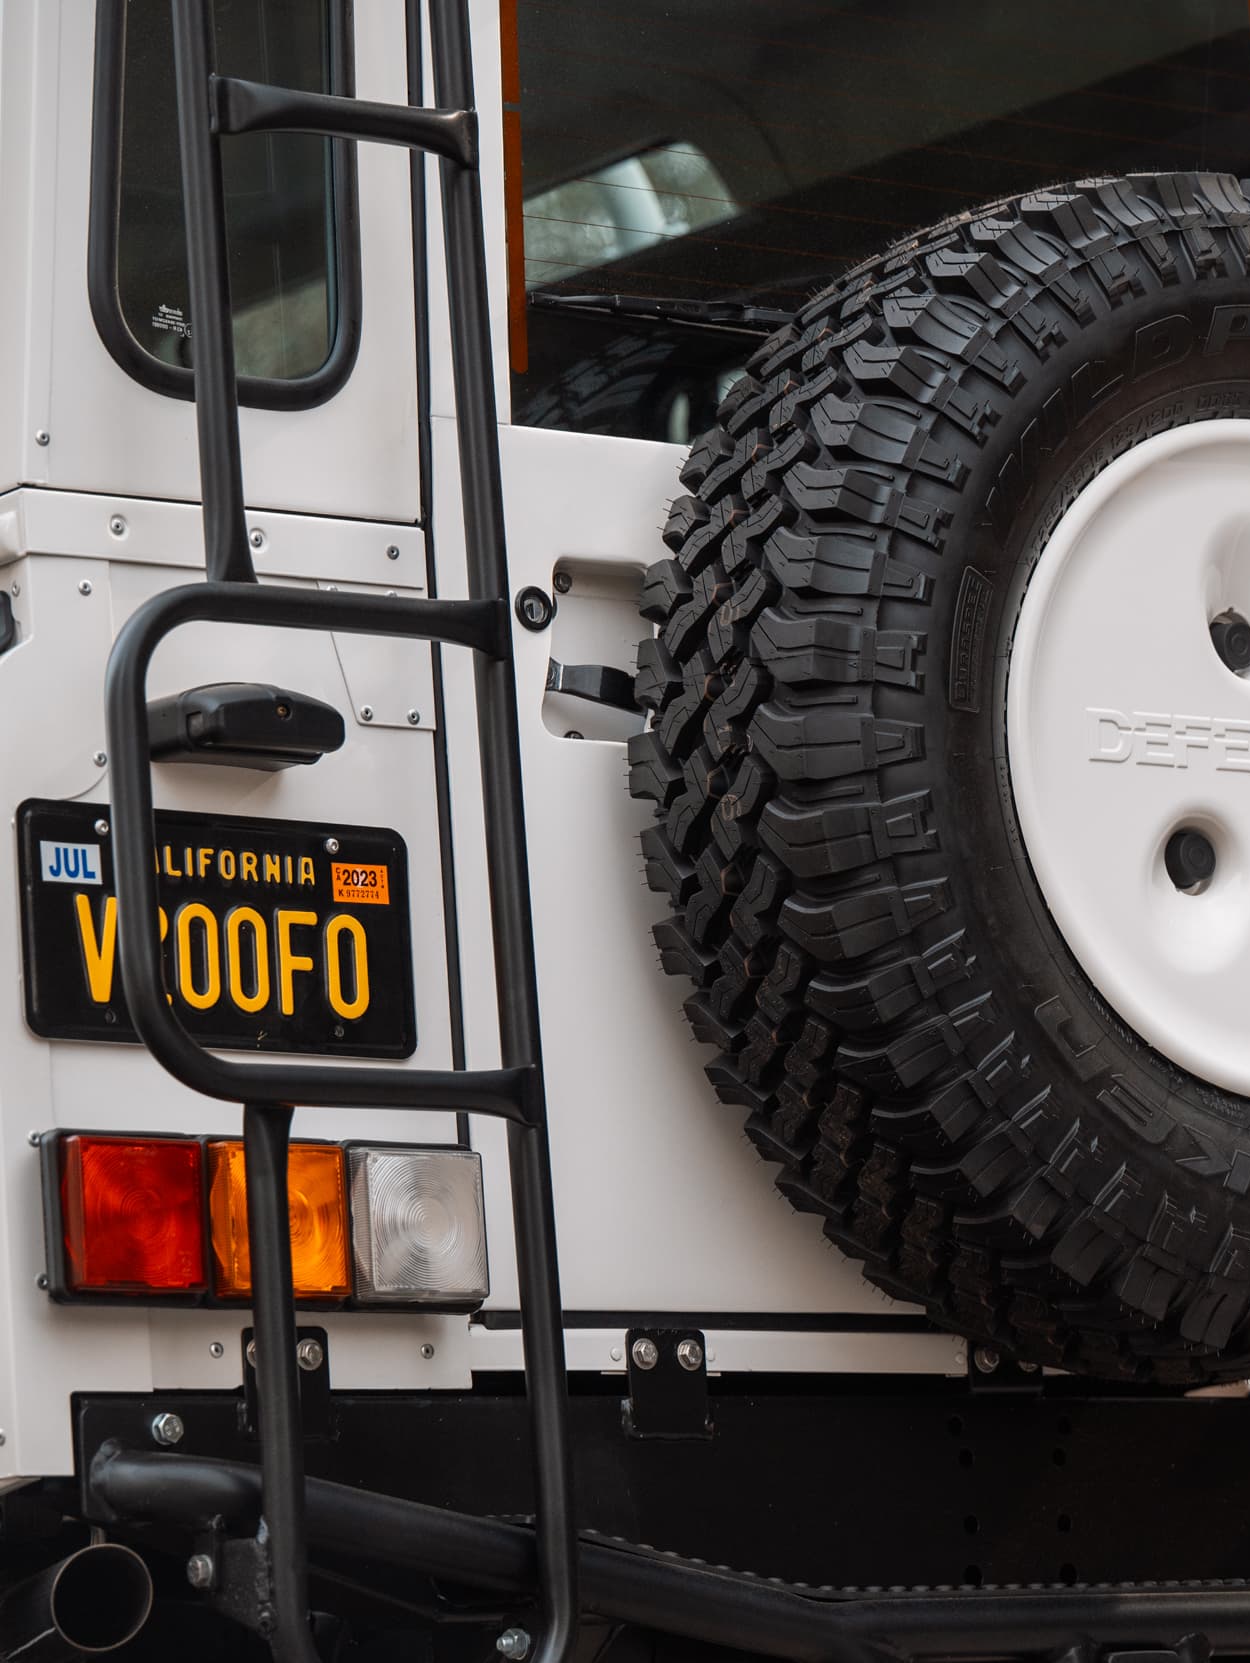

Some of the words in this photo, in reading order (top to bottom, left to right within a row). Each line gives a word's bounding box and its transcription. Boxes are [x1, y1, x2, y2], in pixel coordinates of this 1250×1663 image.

[49, 846, 96, 879] JUL
[154, 845, 315, 886] LIFORNIA
[342, 869, 378, 887] 2023
